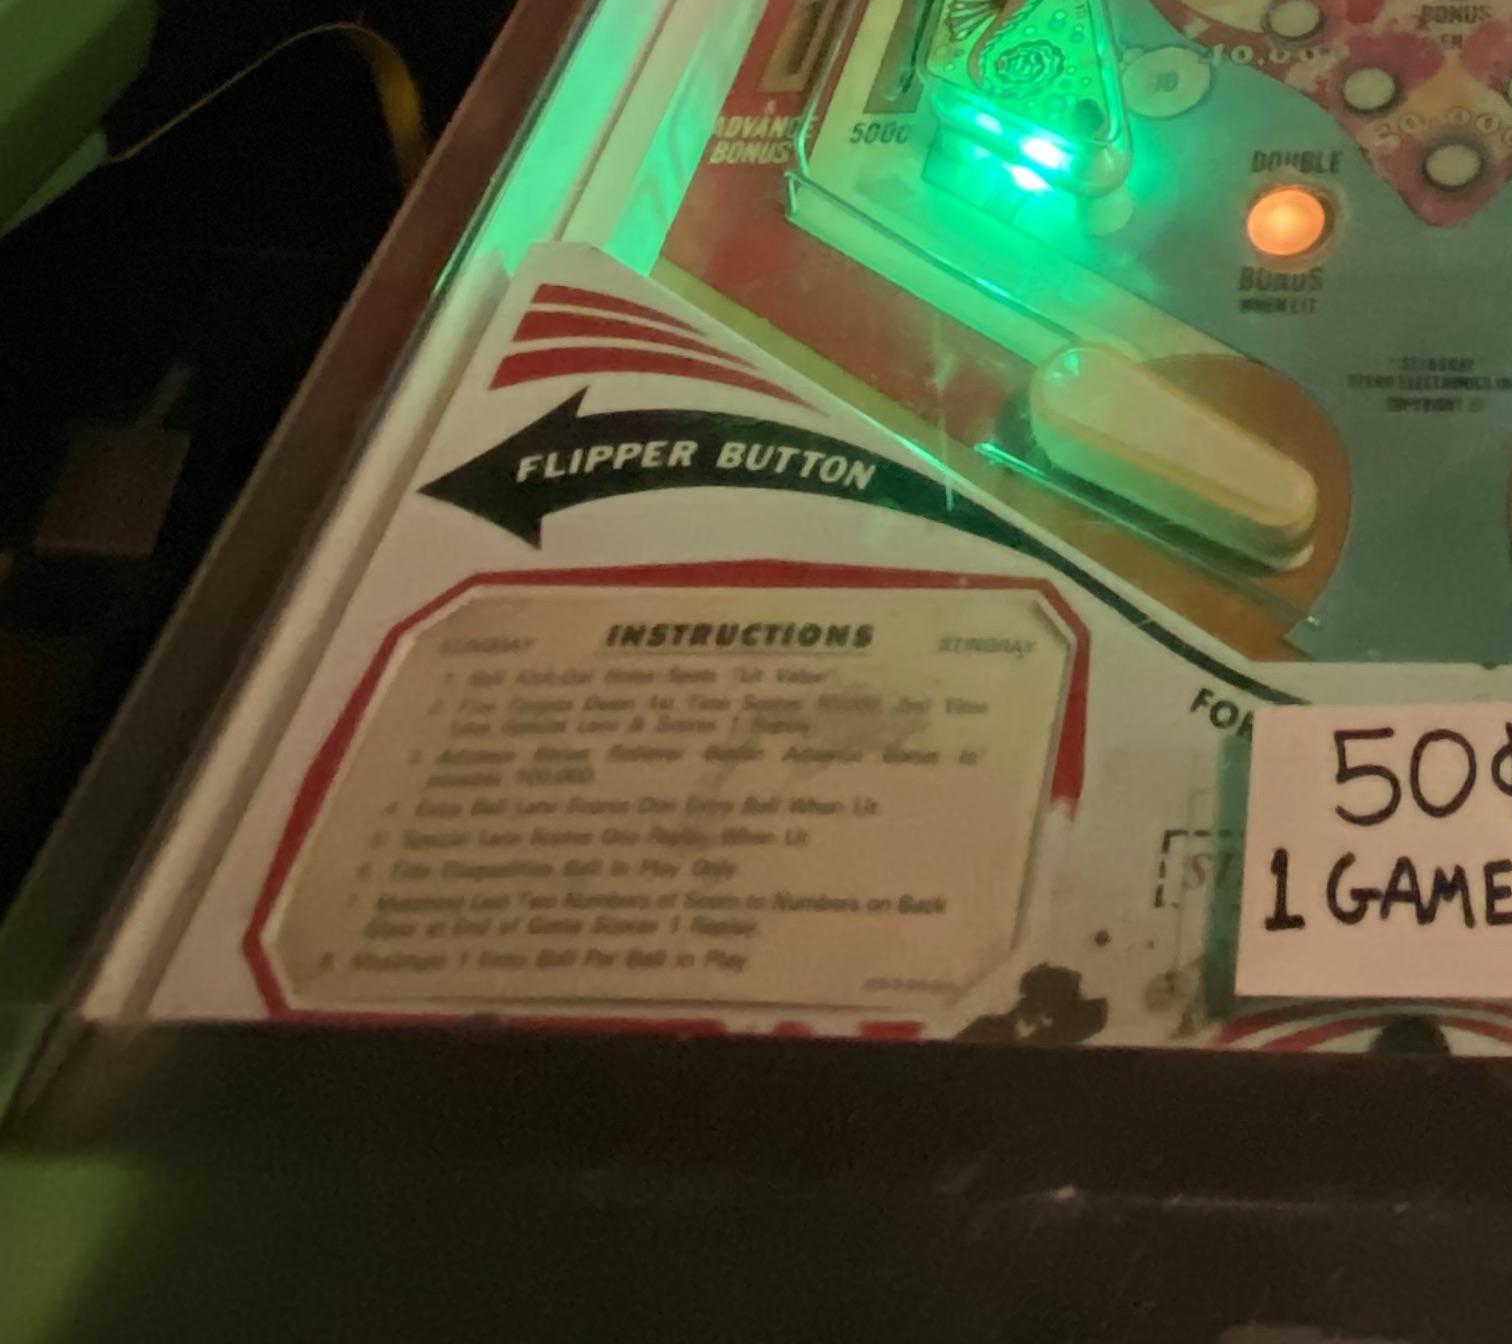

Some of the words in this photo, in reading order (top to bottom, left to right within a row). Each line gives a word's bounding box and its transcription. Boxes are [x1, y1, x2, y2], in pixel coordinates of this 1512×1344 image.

[849, 121, 912, 144] 5000
[708, 140, 794, 165] BONUS
[1250, 150, 1343, 174] DOUBLE
[1238, 266, 1325, 293] BONUS
[516, 439, 698, 483] FLIPPER
[716, 442, 877, 491] BUTTON
[606, 622, 875, 649] INSTRUCTIONS
[1264, 846, 1305, 931] 1
